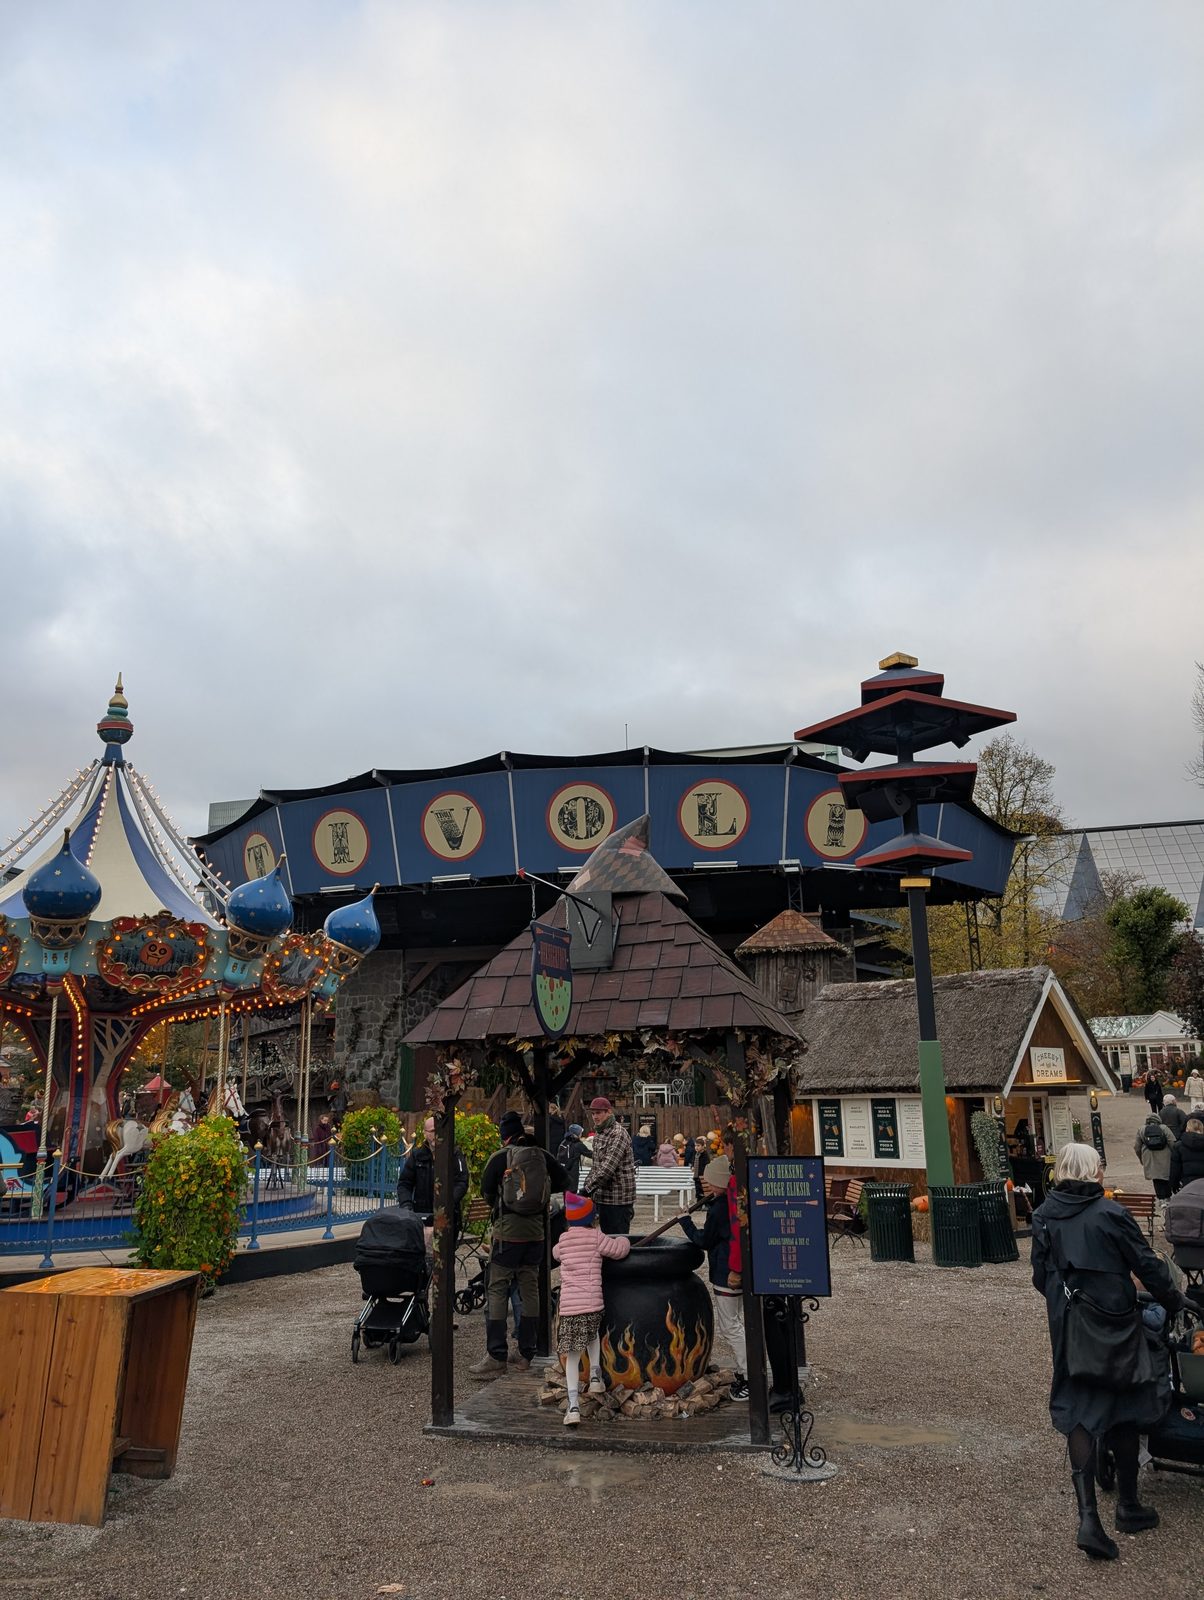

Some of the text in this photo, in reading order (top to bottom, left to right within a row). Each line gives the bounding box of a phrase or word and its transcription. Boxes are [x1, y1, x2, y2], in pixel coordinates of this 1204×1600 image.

[247, 792, 847, 878] TIVOLI
[1036, 1069, 1063, 1078] DREAMS
[767, 1164, 804, 1179] SE HEKSENE
[762, 1181, 811, 1197] BRYGGE ELIKSIR
